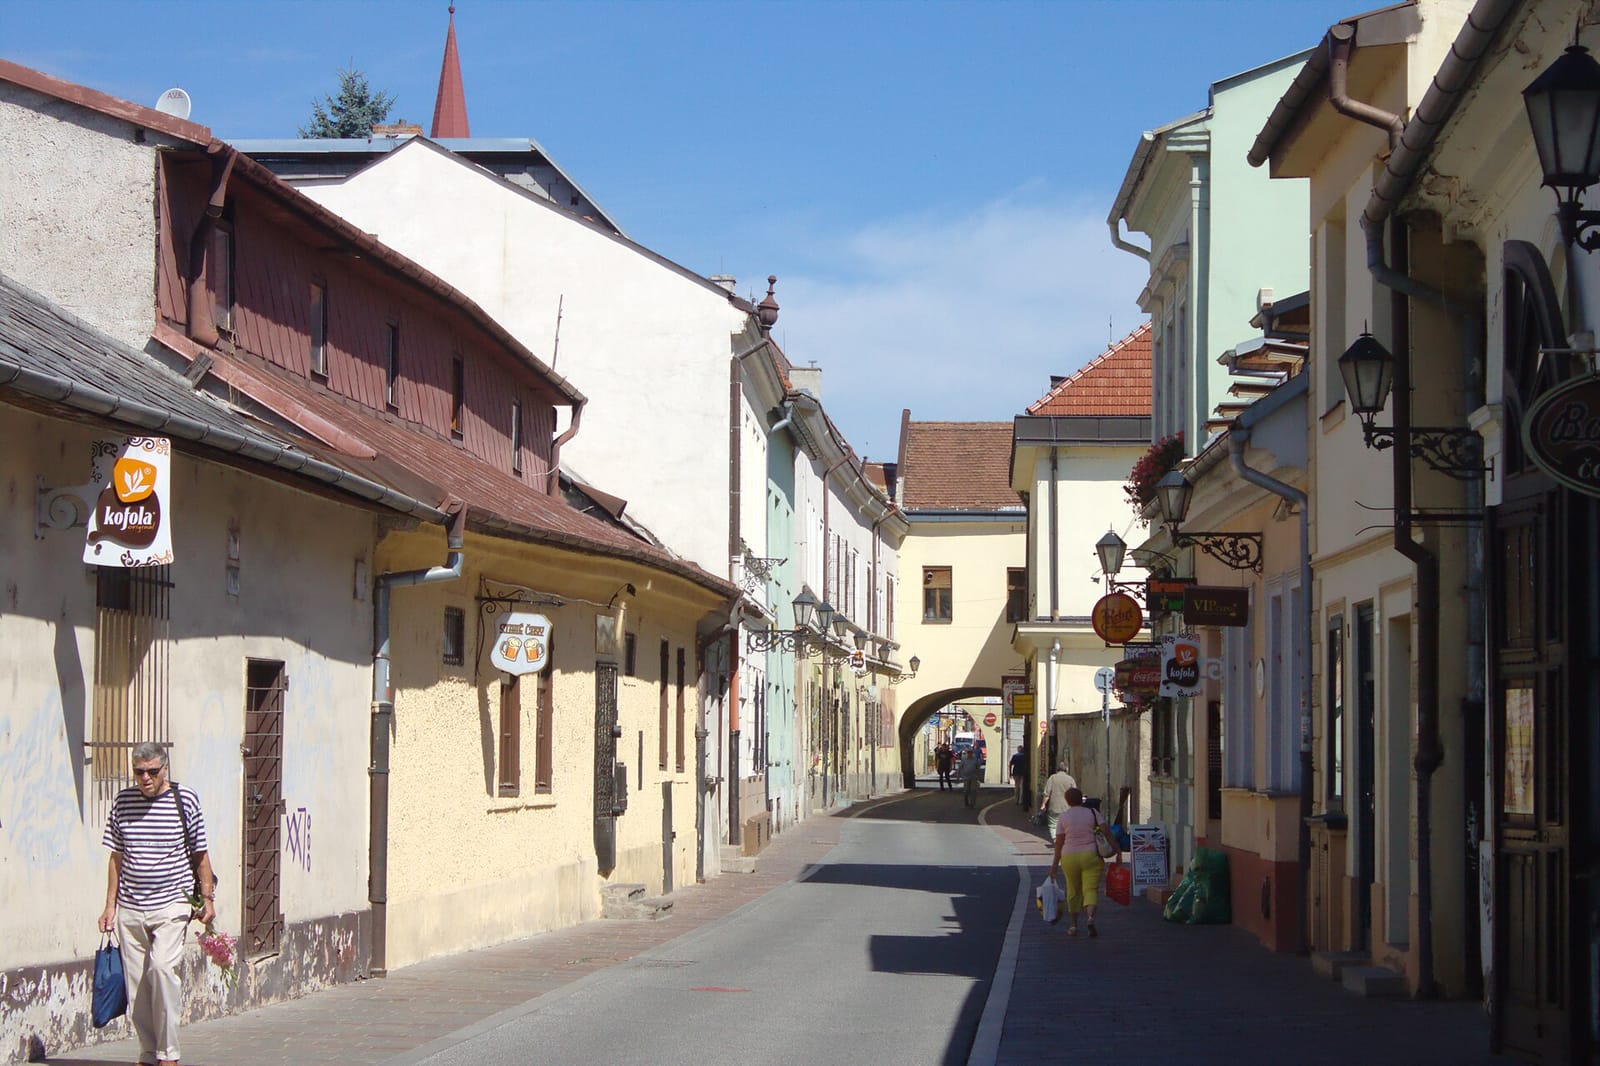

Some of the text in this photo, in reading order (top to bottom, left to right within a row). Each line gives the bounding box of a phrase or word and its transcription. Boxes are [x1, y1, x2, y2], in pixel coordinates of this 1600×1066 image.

[104, 506, 152, 530] kofola
[1193, 599, 1216, 611] VIP
[1170, 667, 1195, 680] kofola
